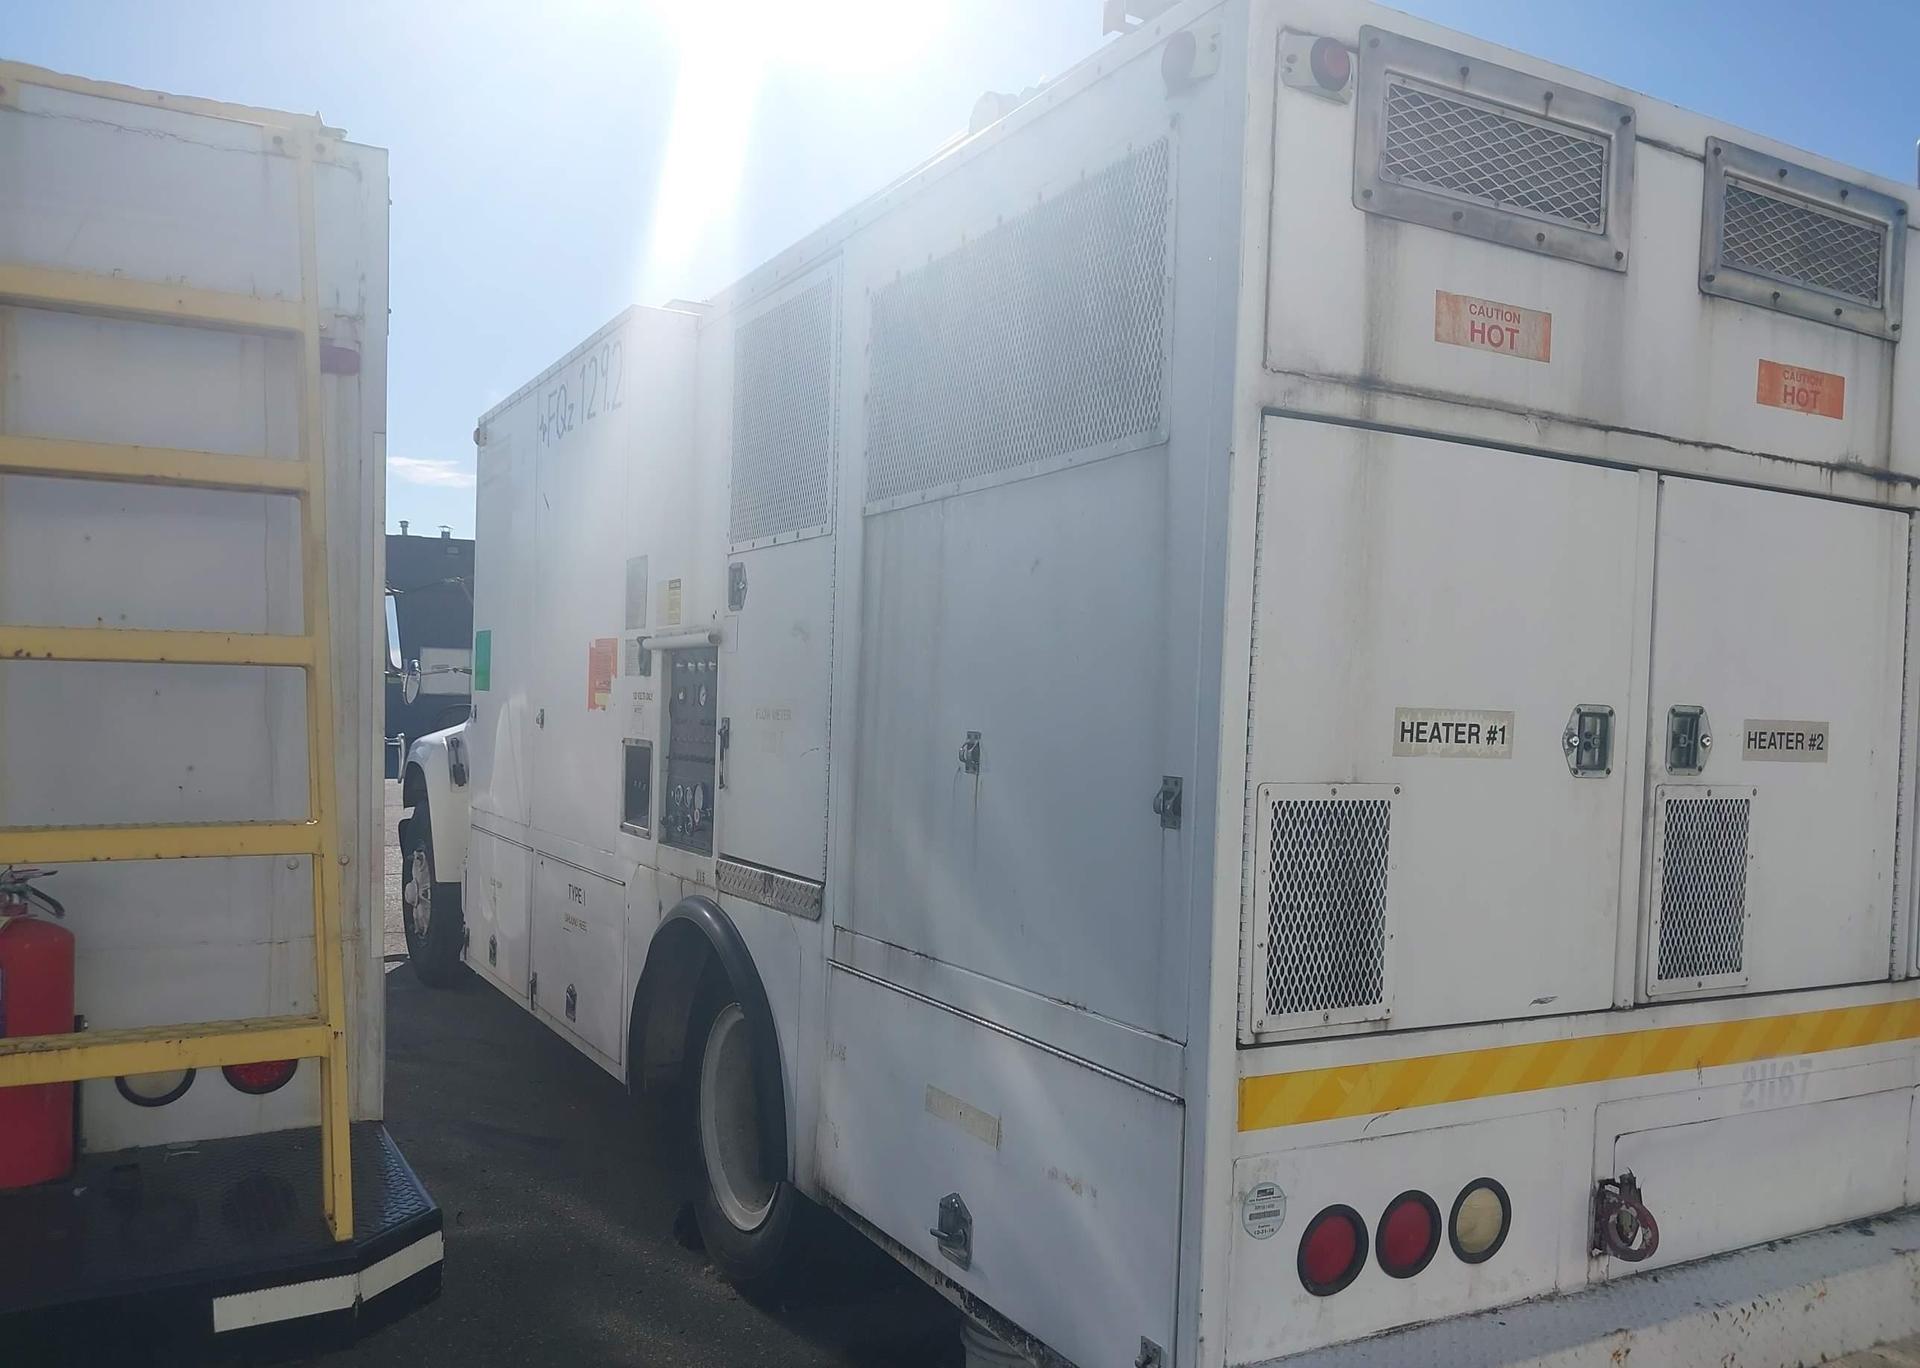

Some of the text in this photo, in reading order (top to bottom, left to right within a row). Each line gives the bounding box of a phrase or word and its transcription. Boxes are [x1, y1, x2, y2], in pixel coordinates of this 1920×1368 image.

[1468, 303, 1521, 324] CAUTION
[1469, 322, 1520, 351] HOT
[1782, 368, 1824, 388] CAUTION
[1782, 385, 1821, 410] HOT
[1399, 721, 1507, 746] HEATER #1
[1746, 731, 1825, 752] HEATER #2
[568, 883, 583, 905] TYPE
